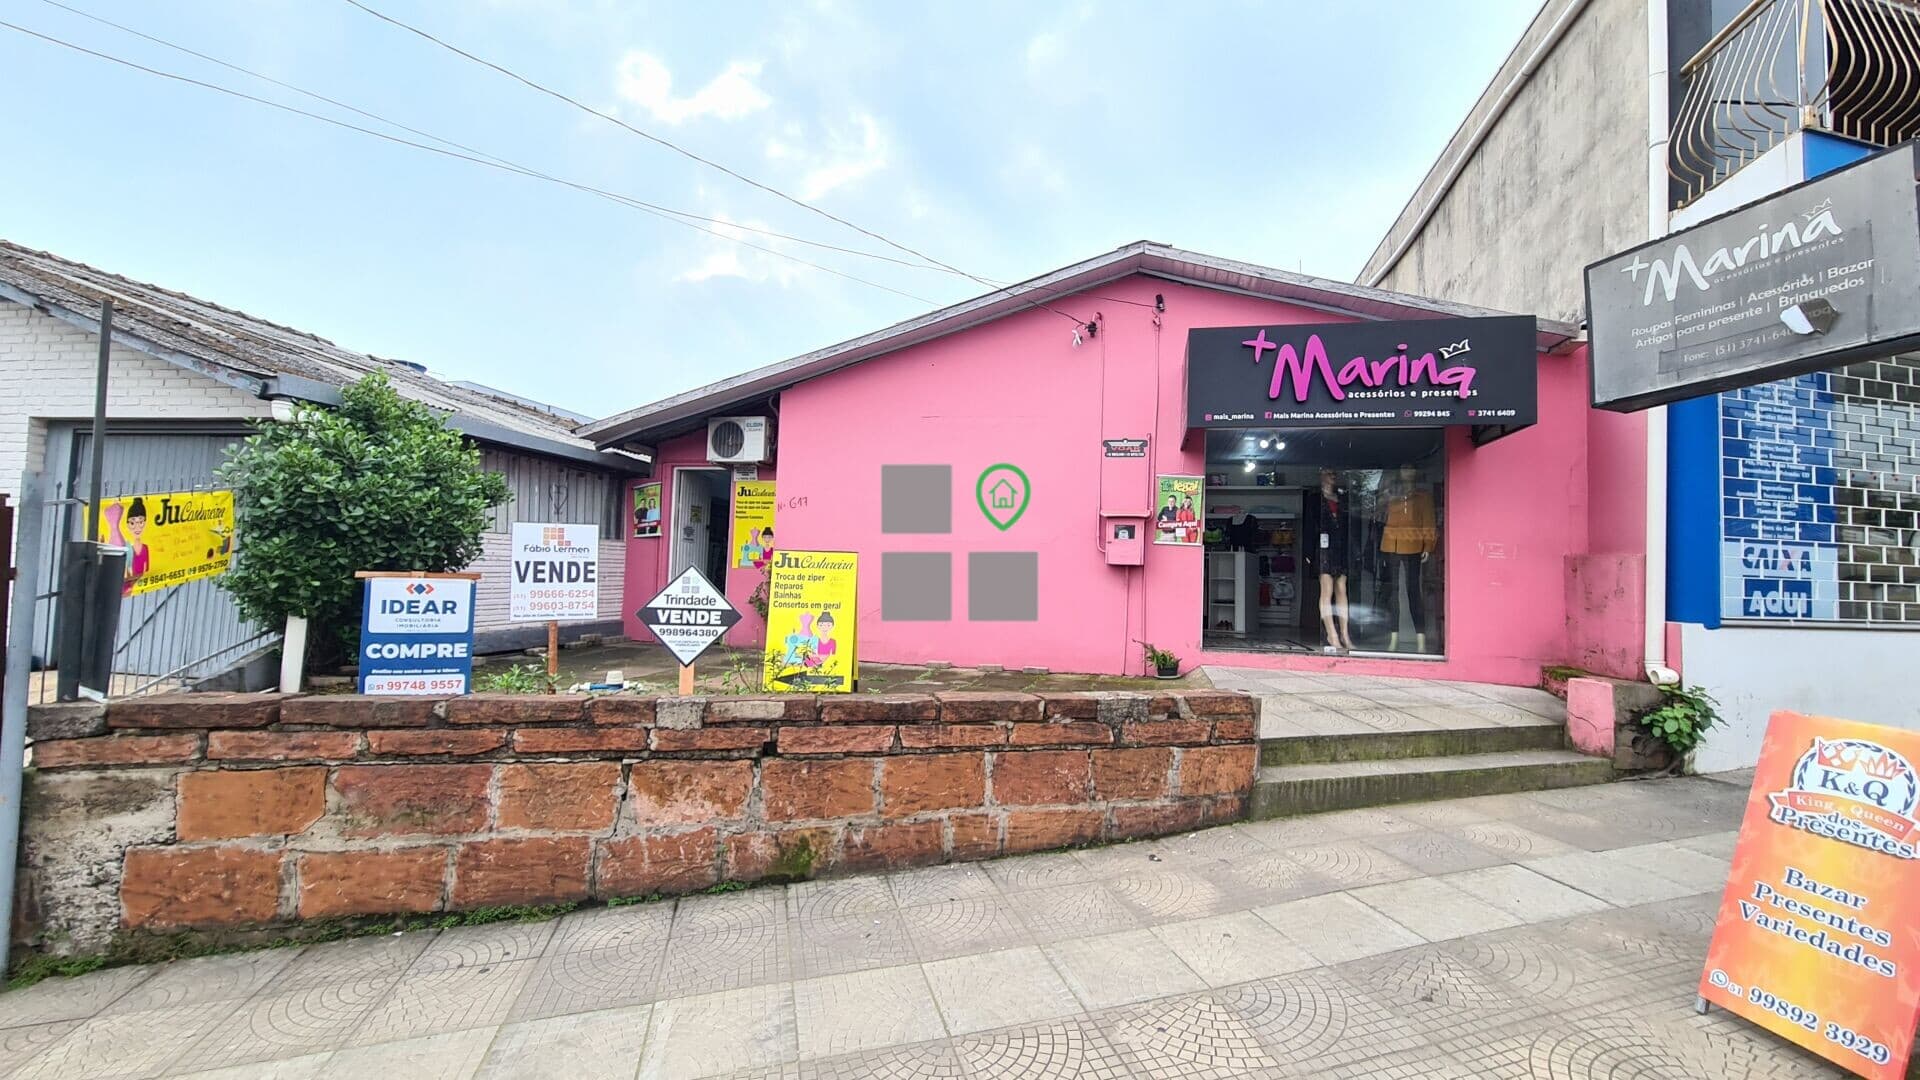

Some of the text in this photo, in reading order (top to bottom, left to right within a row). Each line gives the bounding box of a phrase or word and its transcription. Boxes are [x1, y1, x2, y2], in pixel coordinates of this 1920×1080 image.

[1784, 238, 1845, 262] presentes
[1631, 258, 1875, 337] Roupas Femininas Acessórios Bazar
[1635, 331, 1673, 349] Artigos
[1676, 322, 1705, 339] para
[1708, 305, 1763, 331] presente
[1684, 350, 1710, 363] Fone:
[1715, 342, 1736, 356] (51)
[1347, 389, 1406, 399] acessórios
[1213, 412, 1254, 421] mais_marina
[1290, 411, 1314, 419] Marina
[1315, 410, 1352, 419] Acessórios
[1359, 410, 1395, 419] Presentes
[1477, 409, 1495, 417] 3741
[737, 486, 751, 497] Ju
[154, 499, 180, 526] Ju
[523, 544, 590, 553] Fábio Lermen
[774, 552, 800, 569] Ju
[1742, 546, 1812, 572] CAIXA
[514, 560, 596, 583] VENDE
[775, 573, 795, 581] Troca
[796, 573, 806, 581] de
[529, 590, 595, 599] 99666-6254
[774, 582, 804, 591] Reparos
[663, 594, 717, 606] Trindade
[774, 591, 802, 599] Bainhas
[1749, 590, 1808, 614] AQUI
[381, 599, 457, 615] IDEAR
[529, 602, 595, 611] 99603-8754
[773, 600, 809, 609] Consertos
[823, 602, 841, 610] geral
[657, 609, 722, 625] VENDE
[659, 628, 719, 637] 998964380
[365, 643, 468, 659] COMPRE
[387, 681, 426, 691] 99748
[430, 680, 462, 690] 9557
[1796, 795, 1905, 831] King Queen
[1828, 812, 1864, 830] dos
[1780, 806, 1913, 857] Presentes
[1786, 868, 1867, 909] Bazar
[1754, 883, 1890, 945] Presentes
[1740, 901, 1895, 976] Variedades
[1728, 984, 1889, 1063] 51 99892 3929
